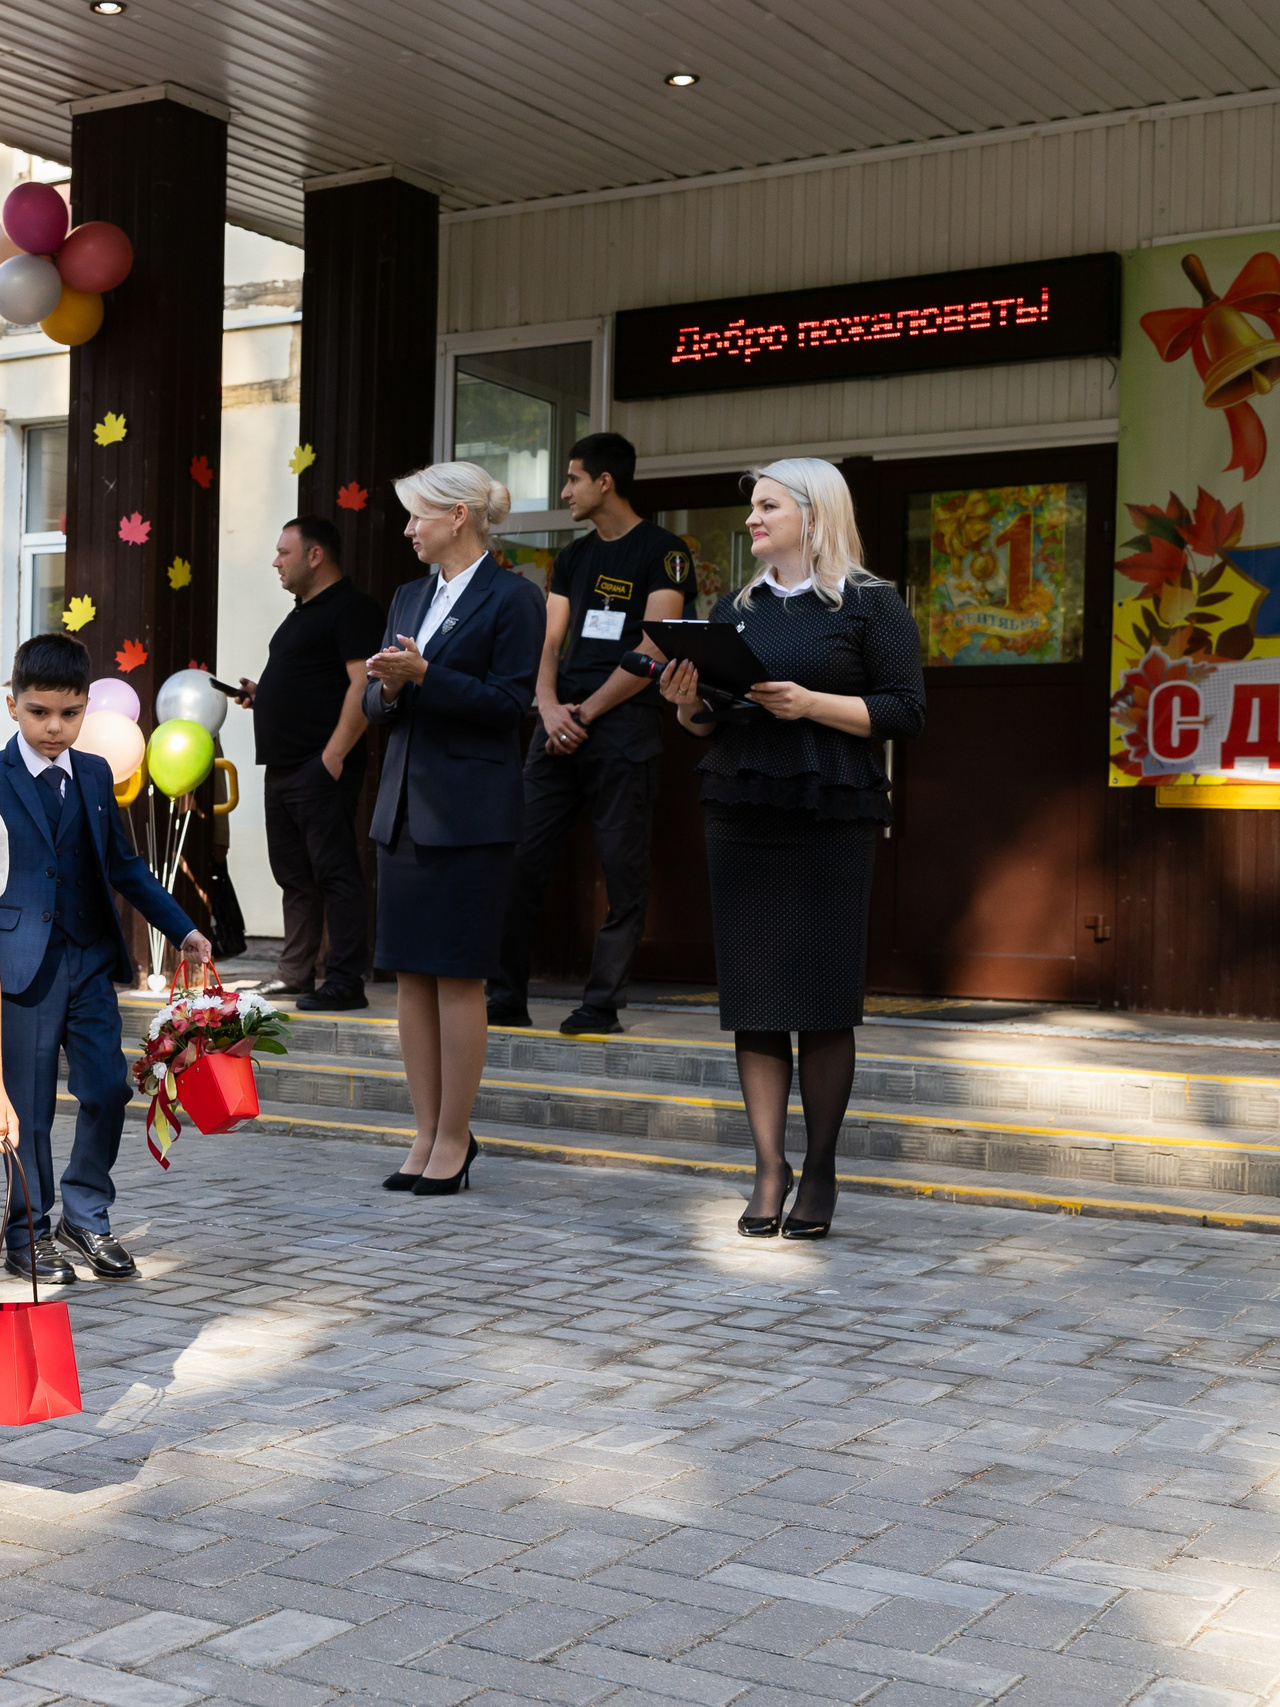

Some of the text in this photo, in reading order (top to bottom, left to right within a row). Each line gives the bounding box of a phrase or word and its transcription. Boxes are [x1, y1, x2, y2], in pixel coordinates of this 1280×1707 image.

[671, 287, 1049, 363] Добро пожаловать!
[600, 581, 626, 593] ОХРАНА
[995, 511, 1034, 609] 1
[955, 613, 1039, 630] СЕНТЯБРЯ
[1151, 683, 1201, 760] С
